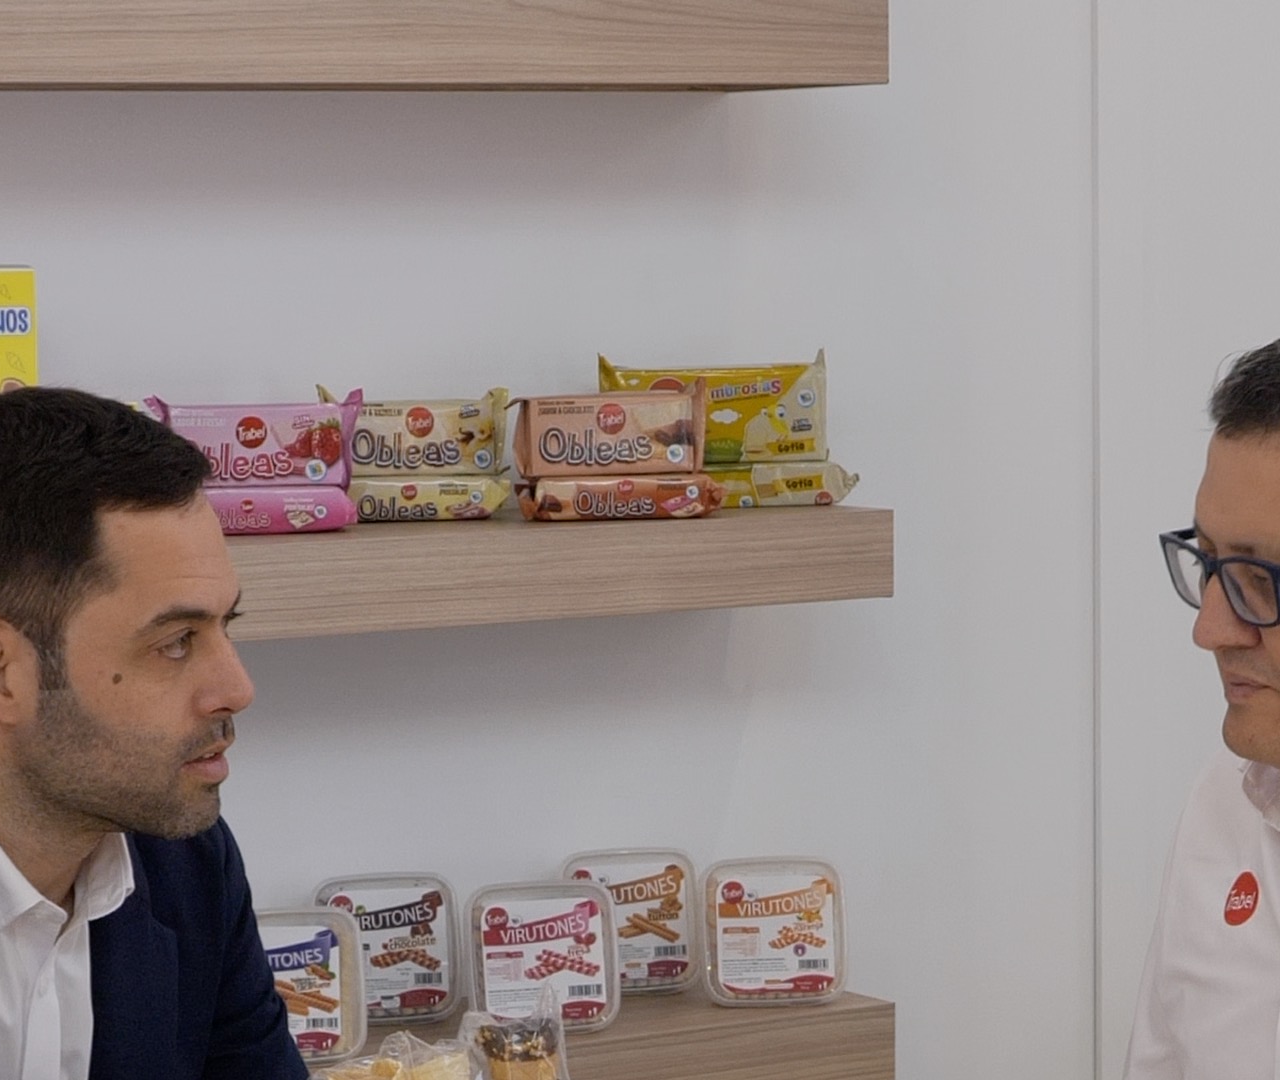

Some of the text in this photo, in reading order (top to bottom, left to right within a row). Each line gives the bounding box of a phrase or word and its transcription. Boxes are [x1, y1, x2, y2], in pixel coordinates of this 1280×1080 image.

[710, 378, 782, 400] mbrosias
[238, 427, 265, 442] Trabel
[540, 427, 653, 466] Obleas
[203, 443, 294, 480] bleas
[352, 429, 460, 470] Obleas
[358, 495, 438, 520] Obleas
[575, 491, 656, 516] Obleas
[220, 508, 270, 529] bleas
[612, 875, 677, 904] UTONES
[360, 902, 434, 930] RUTONES
[736, 891, 823, 916] VIRUTONES
[500, 914, 585, 944] VIRUTONES
[389, 936, 436, 951] chocolate
[268, 948, 323, 969] TONES
